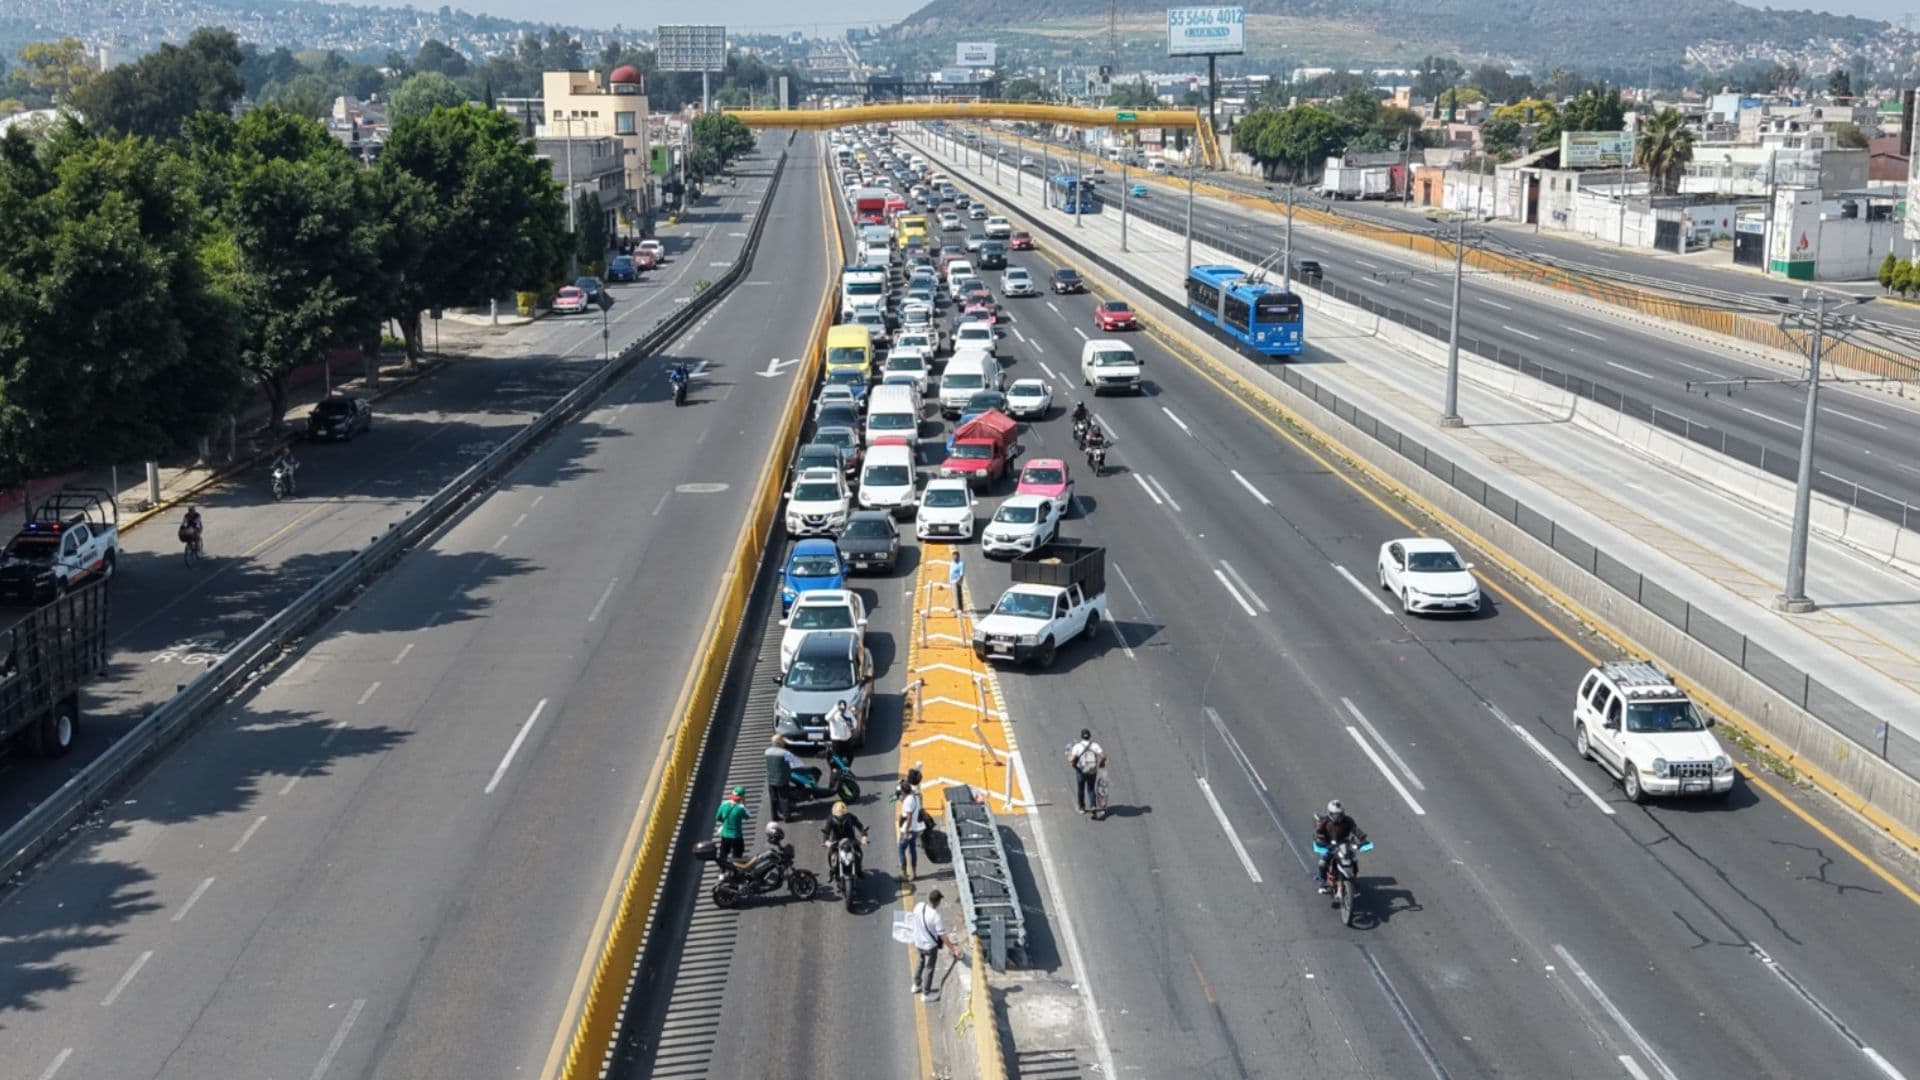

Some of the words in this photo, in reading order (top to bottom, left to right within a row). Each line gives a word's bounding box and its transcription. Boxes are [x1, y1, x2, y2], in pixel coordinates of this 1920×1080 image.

[1170, 10, 1184, 25] 55
[1185, 10, 1214, 25] 5646
[1217, 9, 1243, 24] 4012
